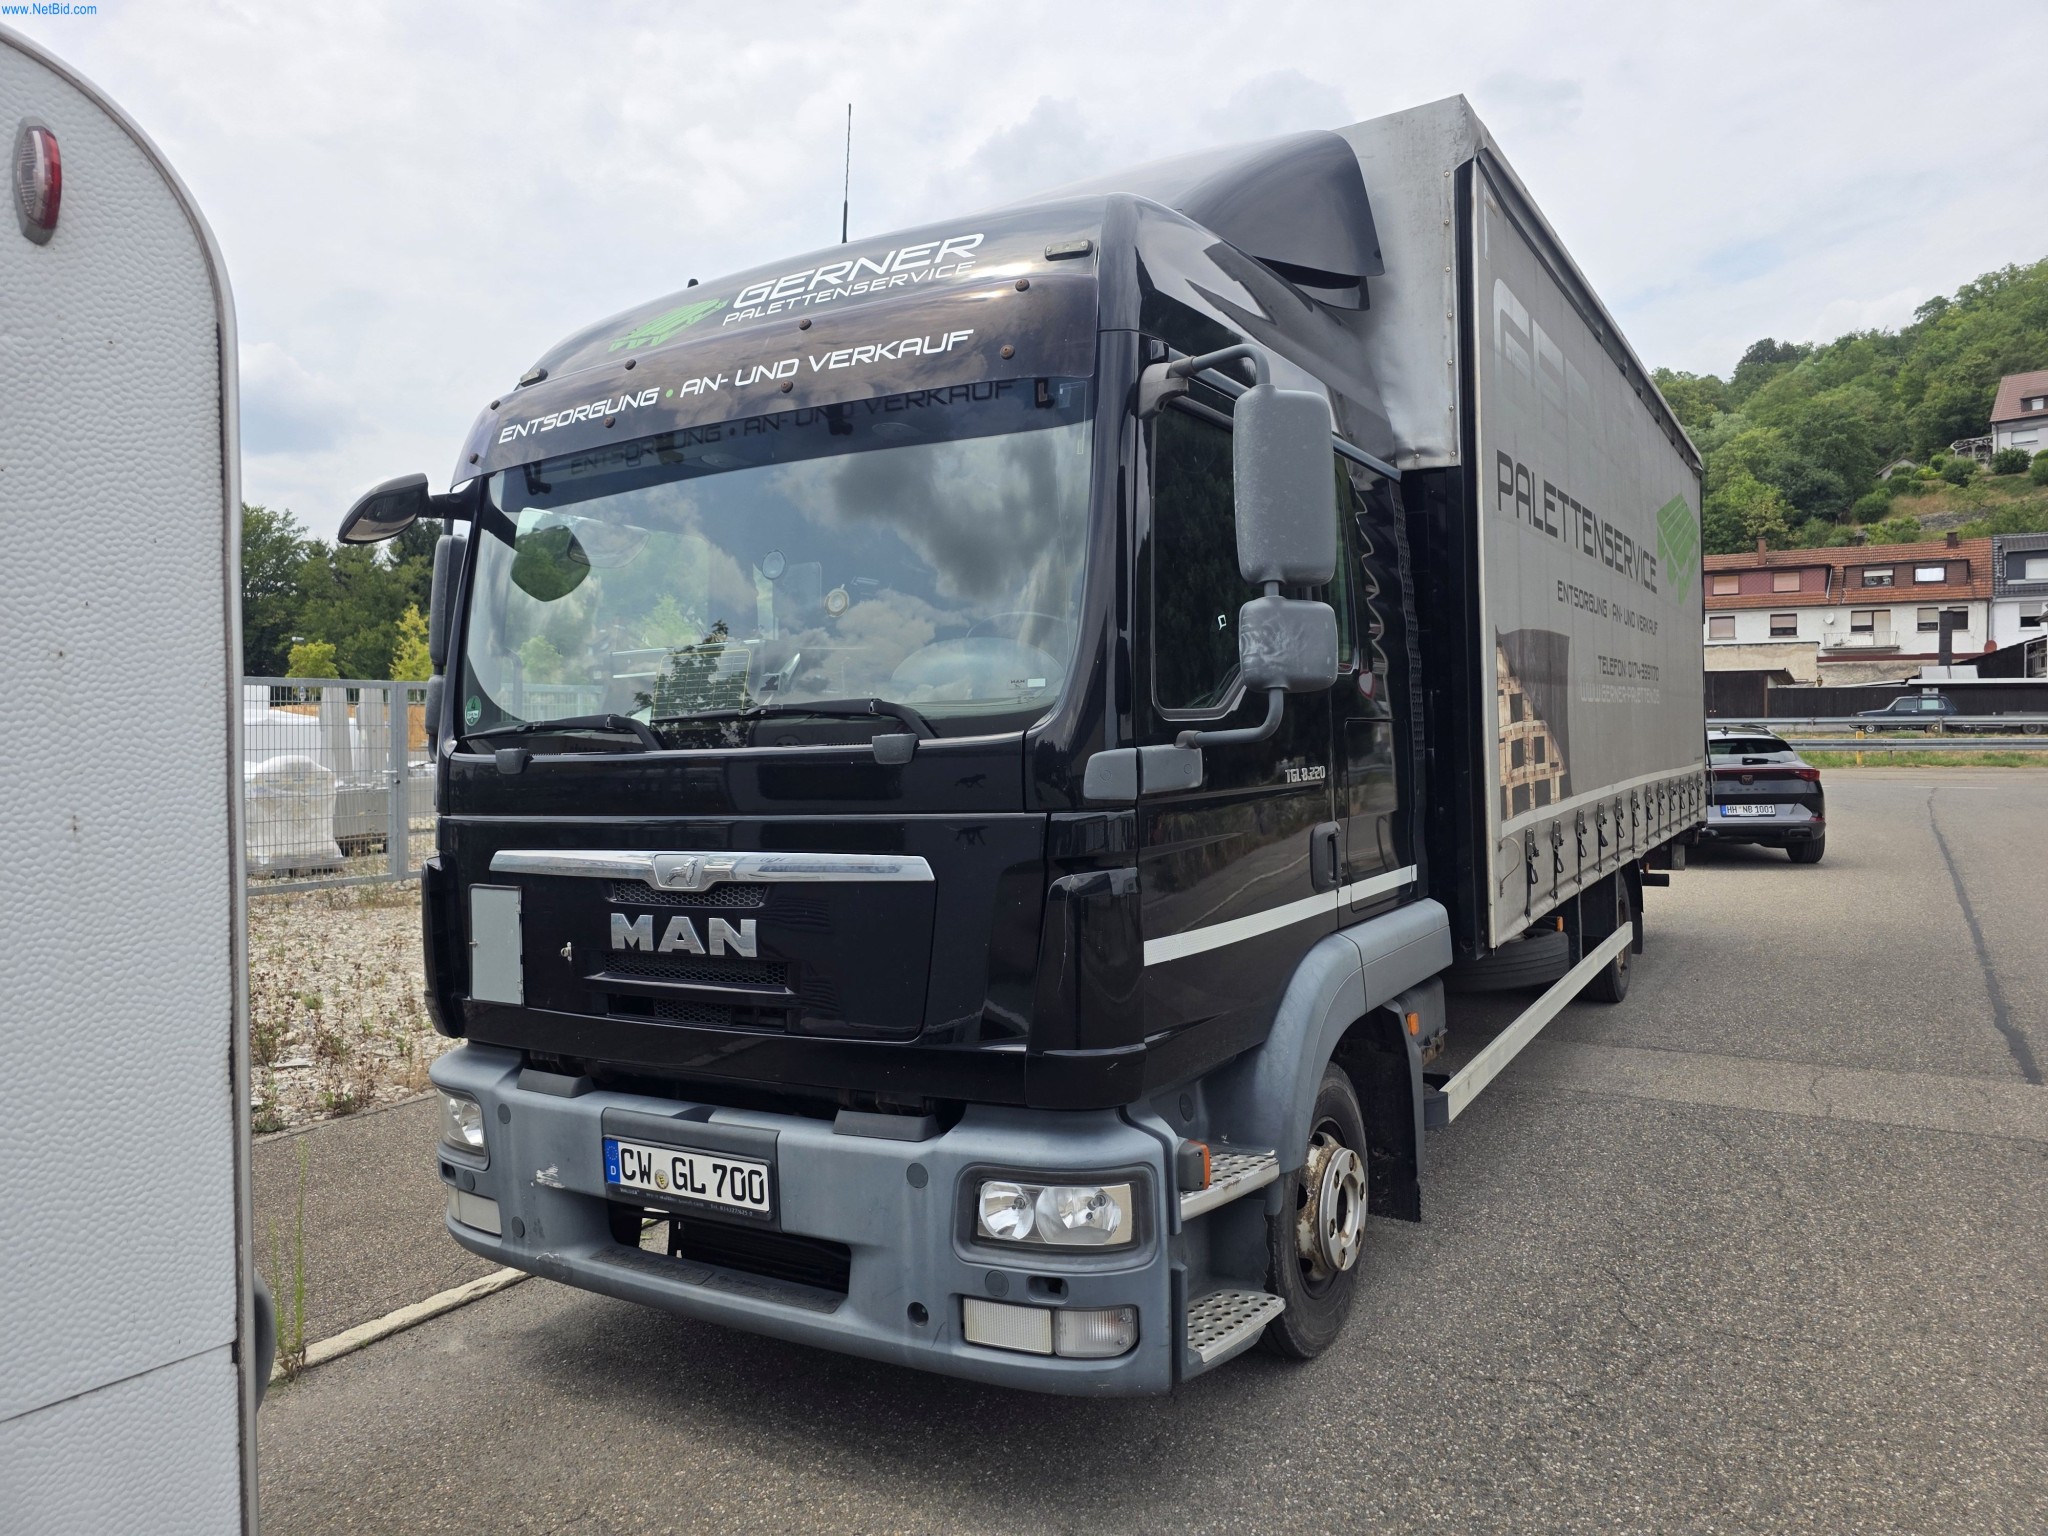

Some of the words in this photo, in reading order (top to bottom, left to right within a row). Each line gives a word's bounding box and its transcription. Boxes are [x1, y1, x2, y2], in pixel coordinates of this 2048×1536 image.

[722, 260, 977, 327] PALETTENSERVICE
[733, 233, 985, 309] GERNER
[498, 387, 661, 444] ENTSORGUNG
[680, 373, 729, 398] AN-
[735, 359, 799, 387] UND
[808, 328, 975, 372] VERKAUF
[1496, 449, 1657, 595] PALETTENSERVICE
[1557, 580, 1608, 618] ENTSORGUNG
[1636, 615, 1659, 636] VERKAUF
[1285, 768, 1301, 783] TGL
[1726, 805, 1738, 814] HH
[1742, 805, 1753, 814] NB
[1755, 805, 1775, 814] 1001
[610, 912, 758, 958] MAN
[620, 1147, 652, 1185] CW
[671, 1157, 706, 1195] GL
[712, 1163, 765, 1205] 700
